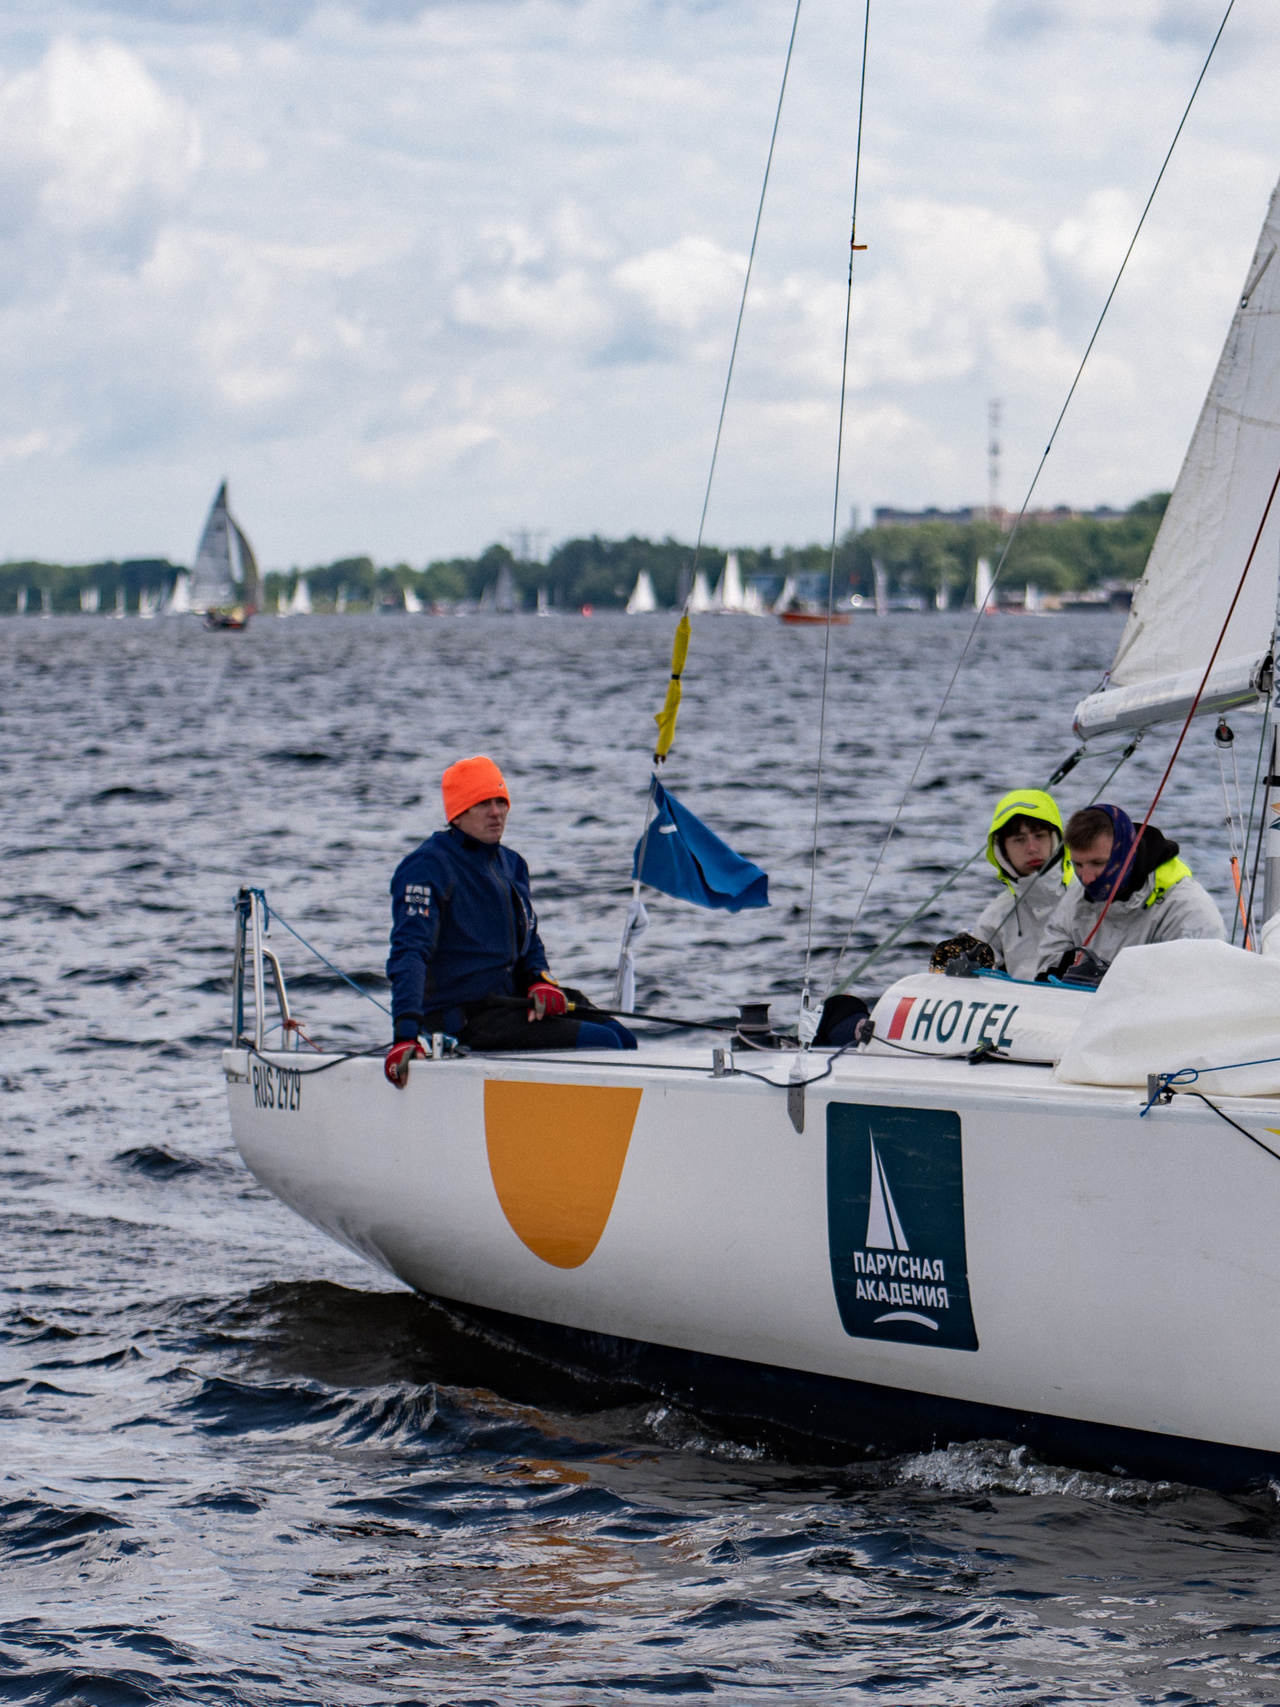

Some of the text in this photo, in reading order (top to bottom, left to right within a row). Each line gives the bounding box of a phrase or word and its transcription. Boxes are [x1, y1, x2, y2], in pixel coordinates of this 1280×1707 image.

[911, 998, 1019, 1048] HOTEL
[253, 1065, 300, 1111] RUS 2929
[853, 1252, 945, 1281] ПАРУСНАЯ
[855, 1279, 949, 1309] АКАДЕМИЯ
